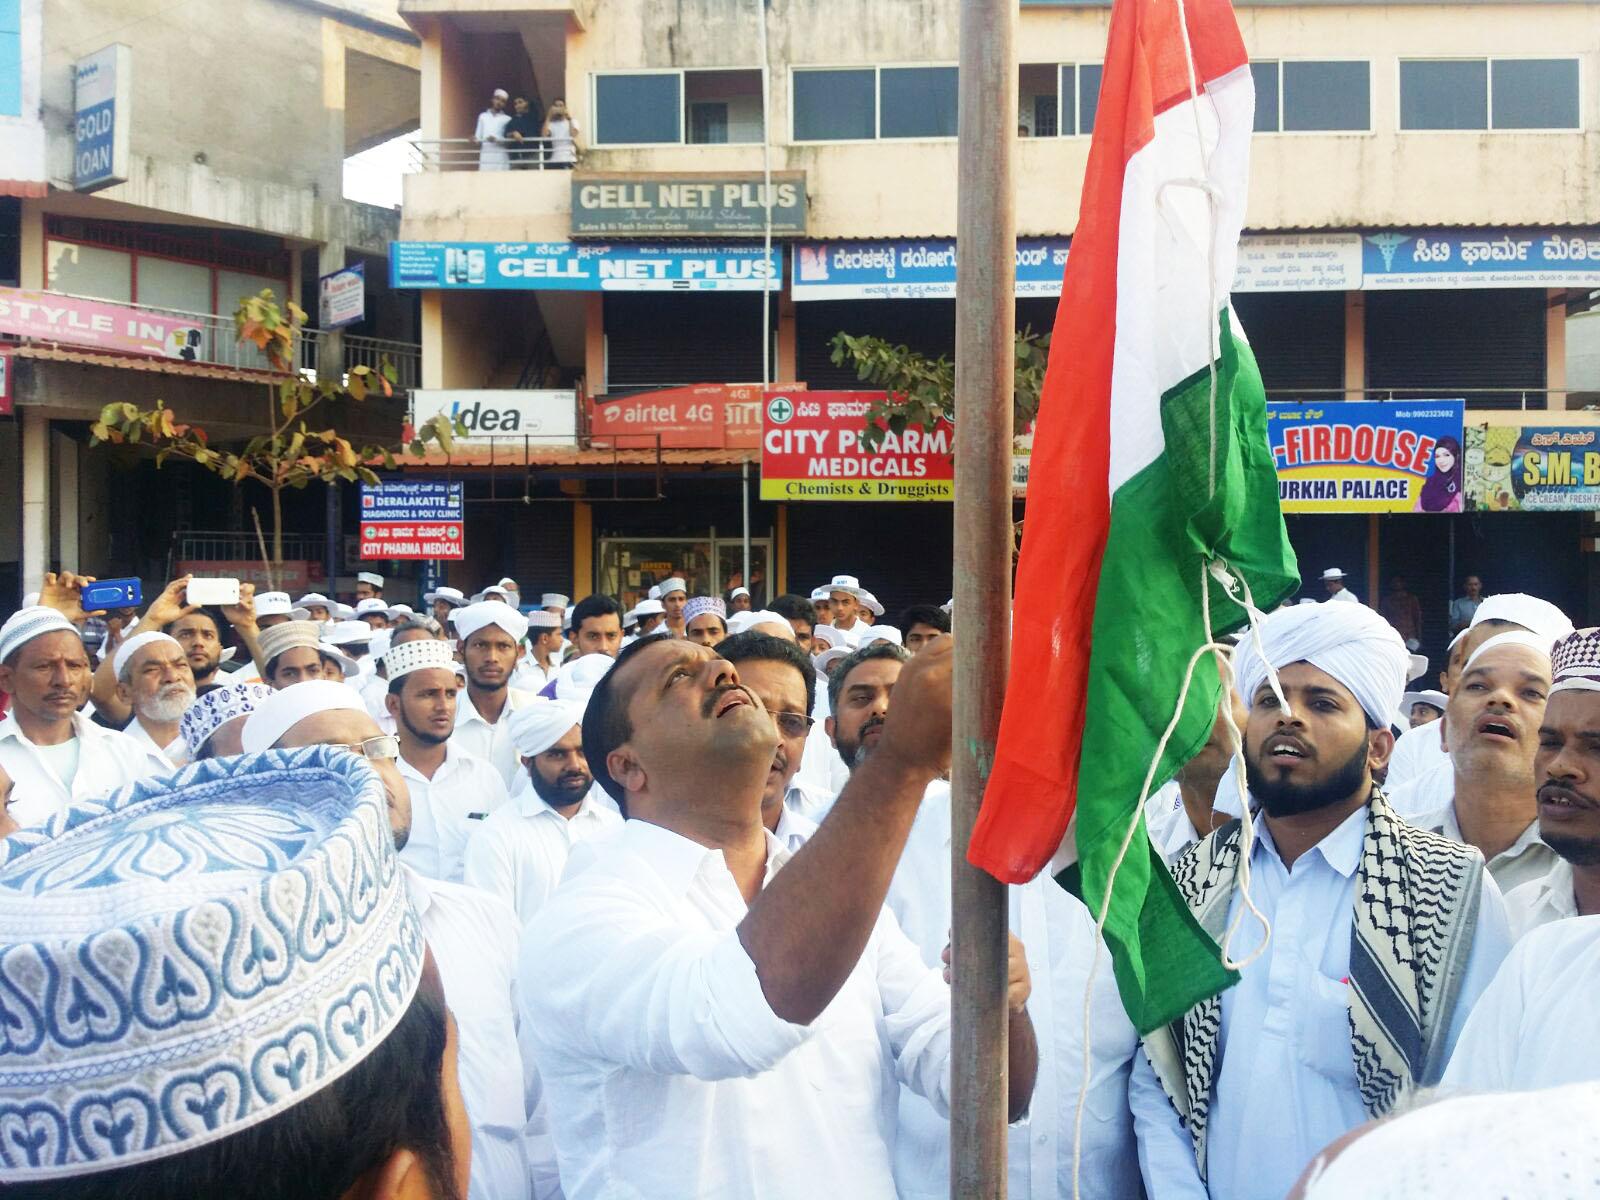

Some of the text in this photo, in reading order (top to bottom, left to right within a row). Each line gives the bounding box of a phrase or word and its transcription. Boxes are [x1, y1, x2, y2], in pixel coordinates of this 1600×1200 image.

[76, 108, 111, 141] GOLD
[76, 144, 110, 177] LOAN
[580, 183, 797, 209] CELL NET PLUS
[498, 258, 777, 279] CELL NET PLUS
[127, 320, 165, 342] IN
[623, 404, 714, 423] airtel 4G
[764, 429, 950, 455] CITY PARM
[1273, 424, 1437, 475] -FIRDOUSE
[808, 457, 927, 478] MEDICALS
[1523, 452, 1577, 486] S.M.
[785, 482, 950, 498] Chemists & Druggists
[1342, 479, 1408, 499] PALACE
[1569, 493, 1593, 504] FRESH
[376, 496, 446, 507] DERALAKATTE
[363, 510, 461, 518] DIAGNOSTICS & POLY CLINIC
[363, 542, 461, 555] CITY PHARMA MEDICAL
